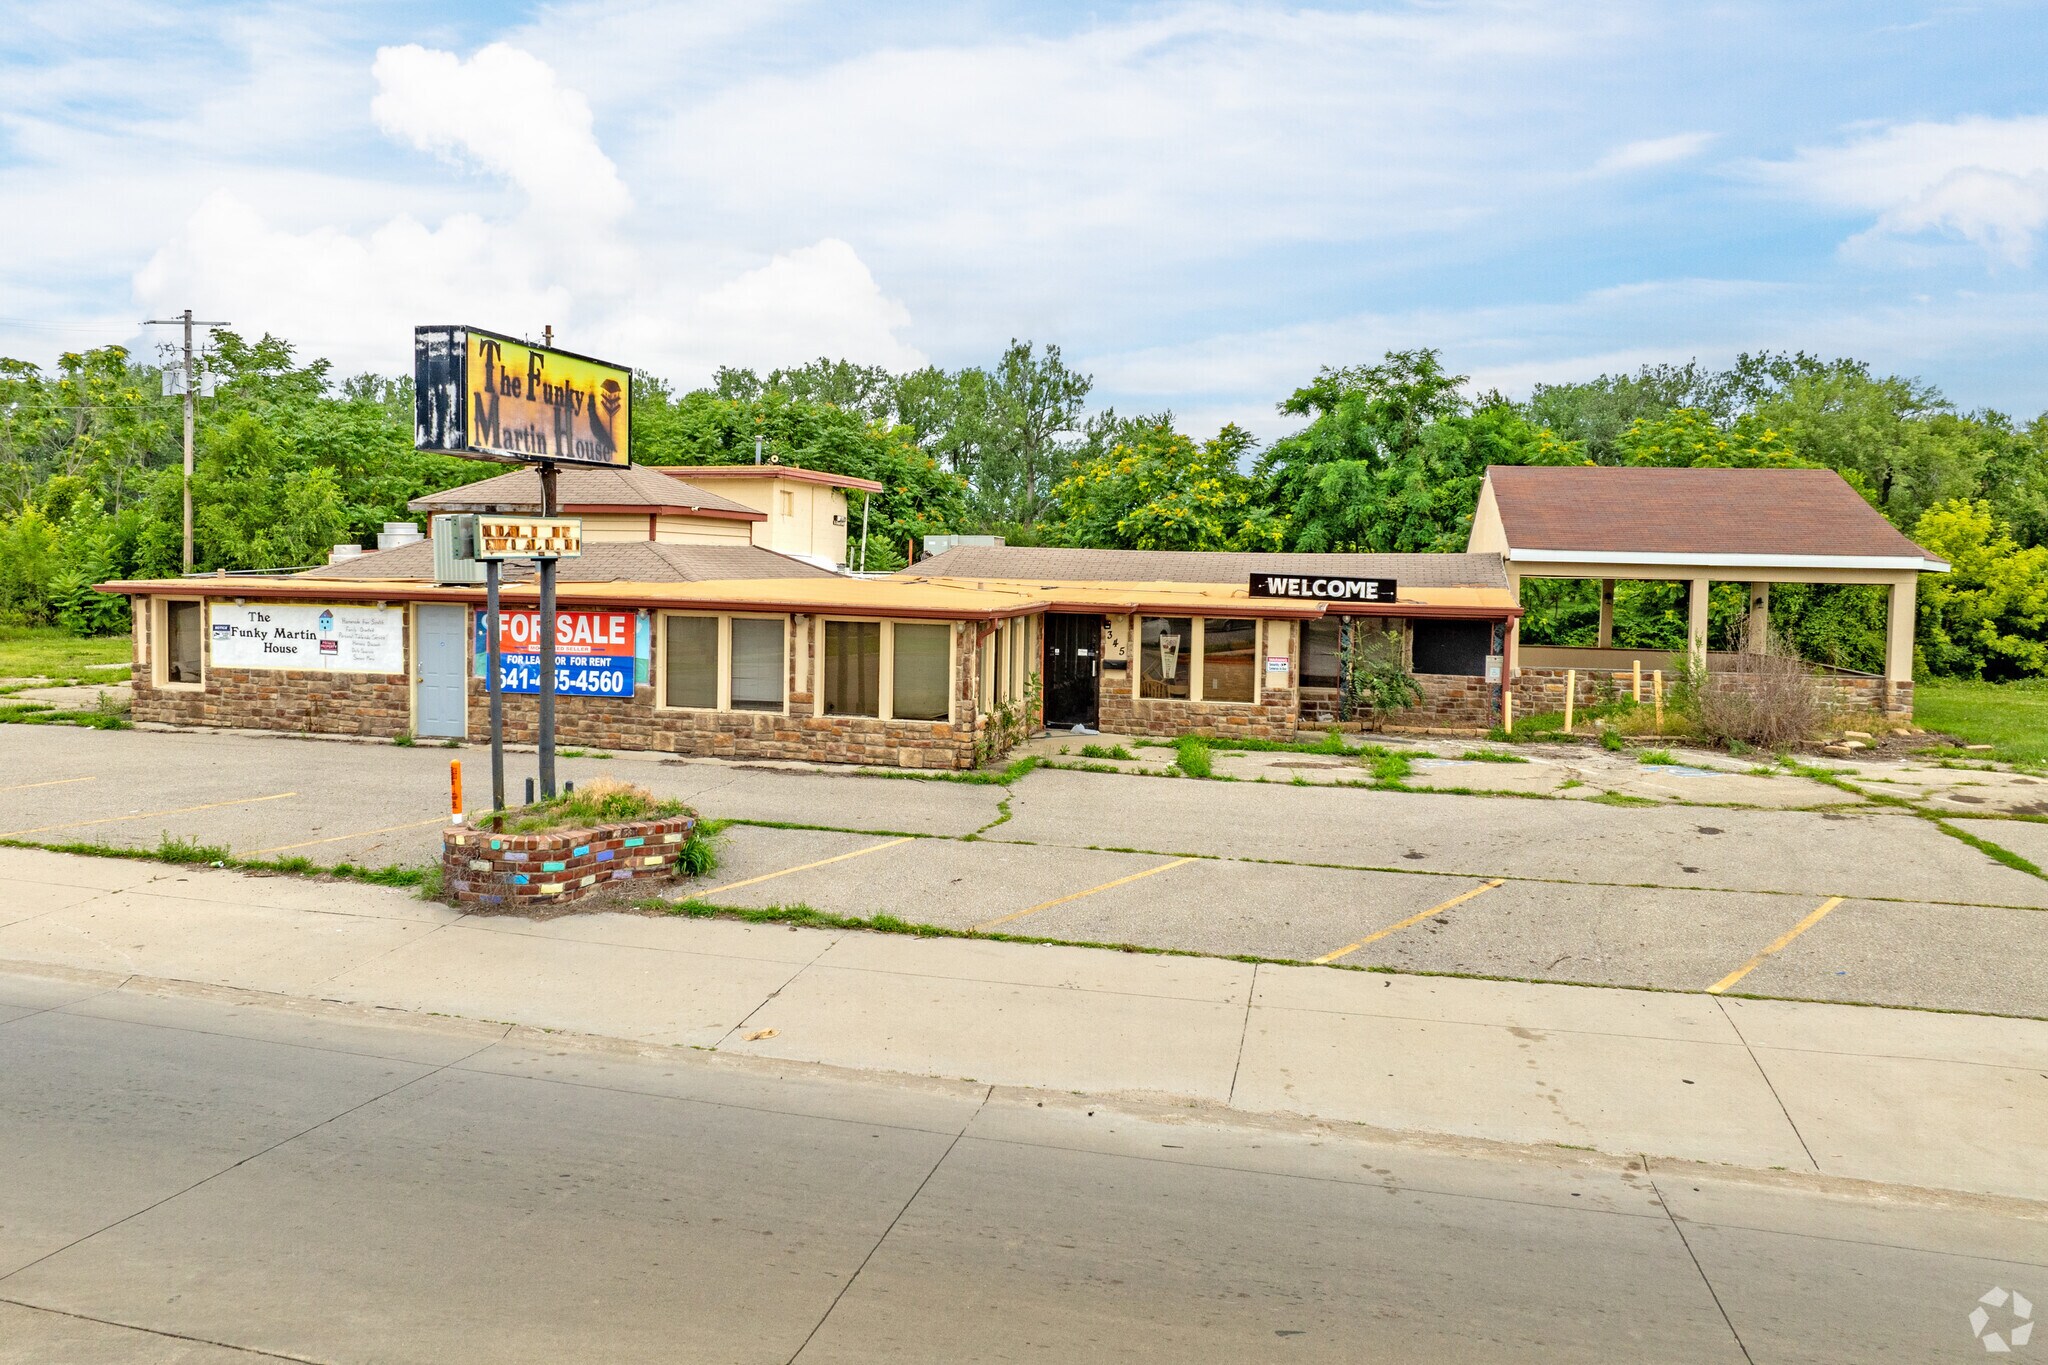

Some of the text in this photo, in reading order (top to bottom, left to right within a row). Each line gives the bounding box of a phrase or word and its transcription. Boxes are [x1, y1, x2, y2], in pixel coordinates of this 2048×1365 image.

[480, 339, 584, 417] The Funky
[474, 392, 612, 462] Martin House
[1267, 577, 1379, 600] WELCOME
[248, 611, 271, 623] The
[231, 626, 267, 640] Funky
[274, 627, 317, 641] Martin
[556, 614, 626, 645] SALE
[263, 642, 298, 655] House
[507, 654, 612, 667] FOR LEA OR FOR RENT
